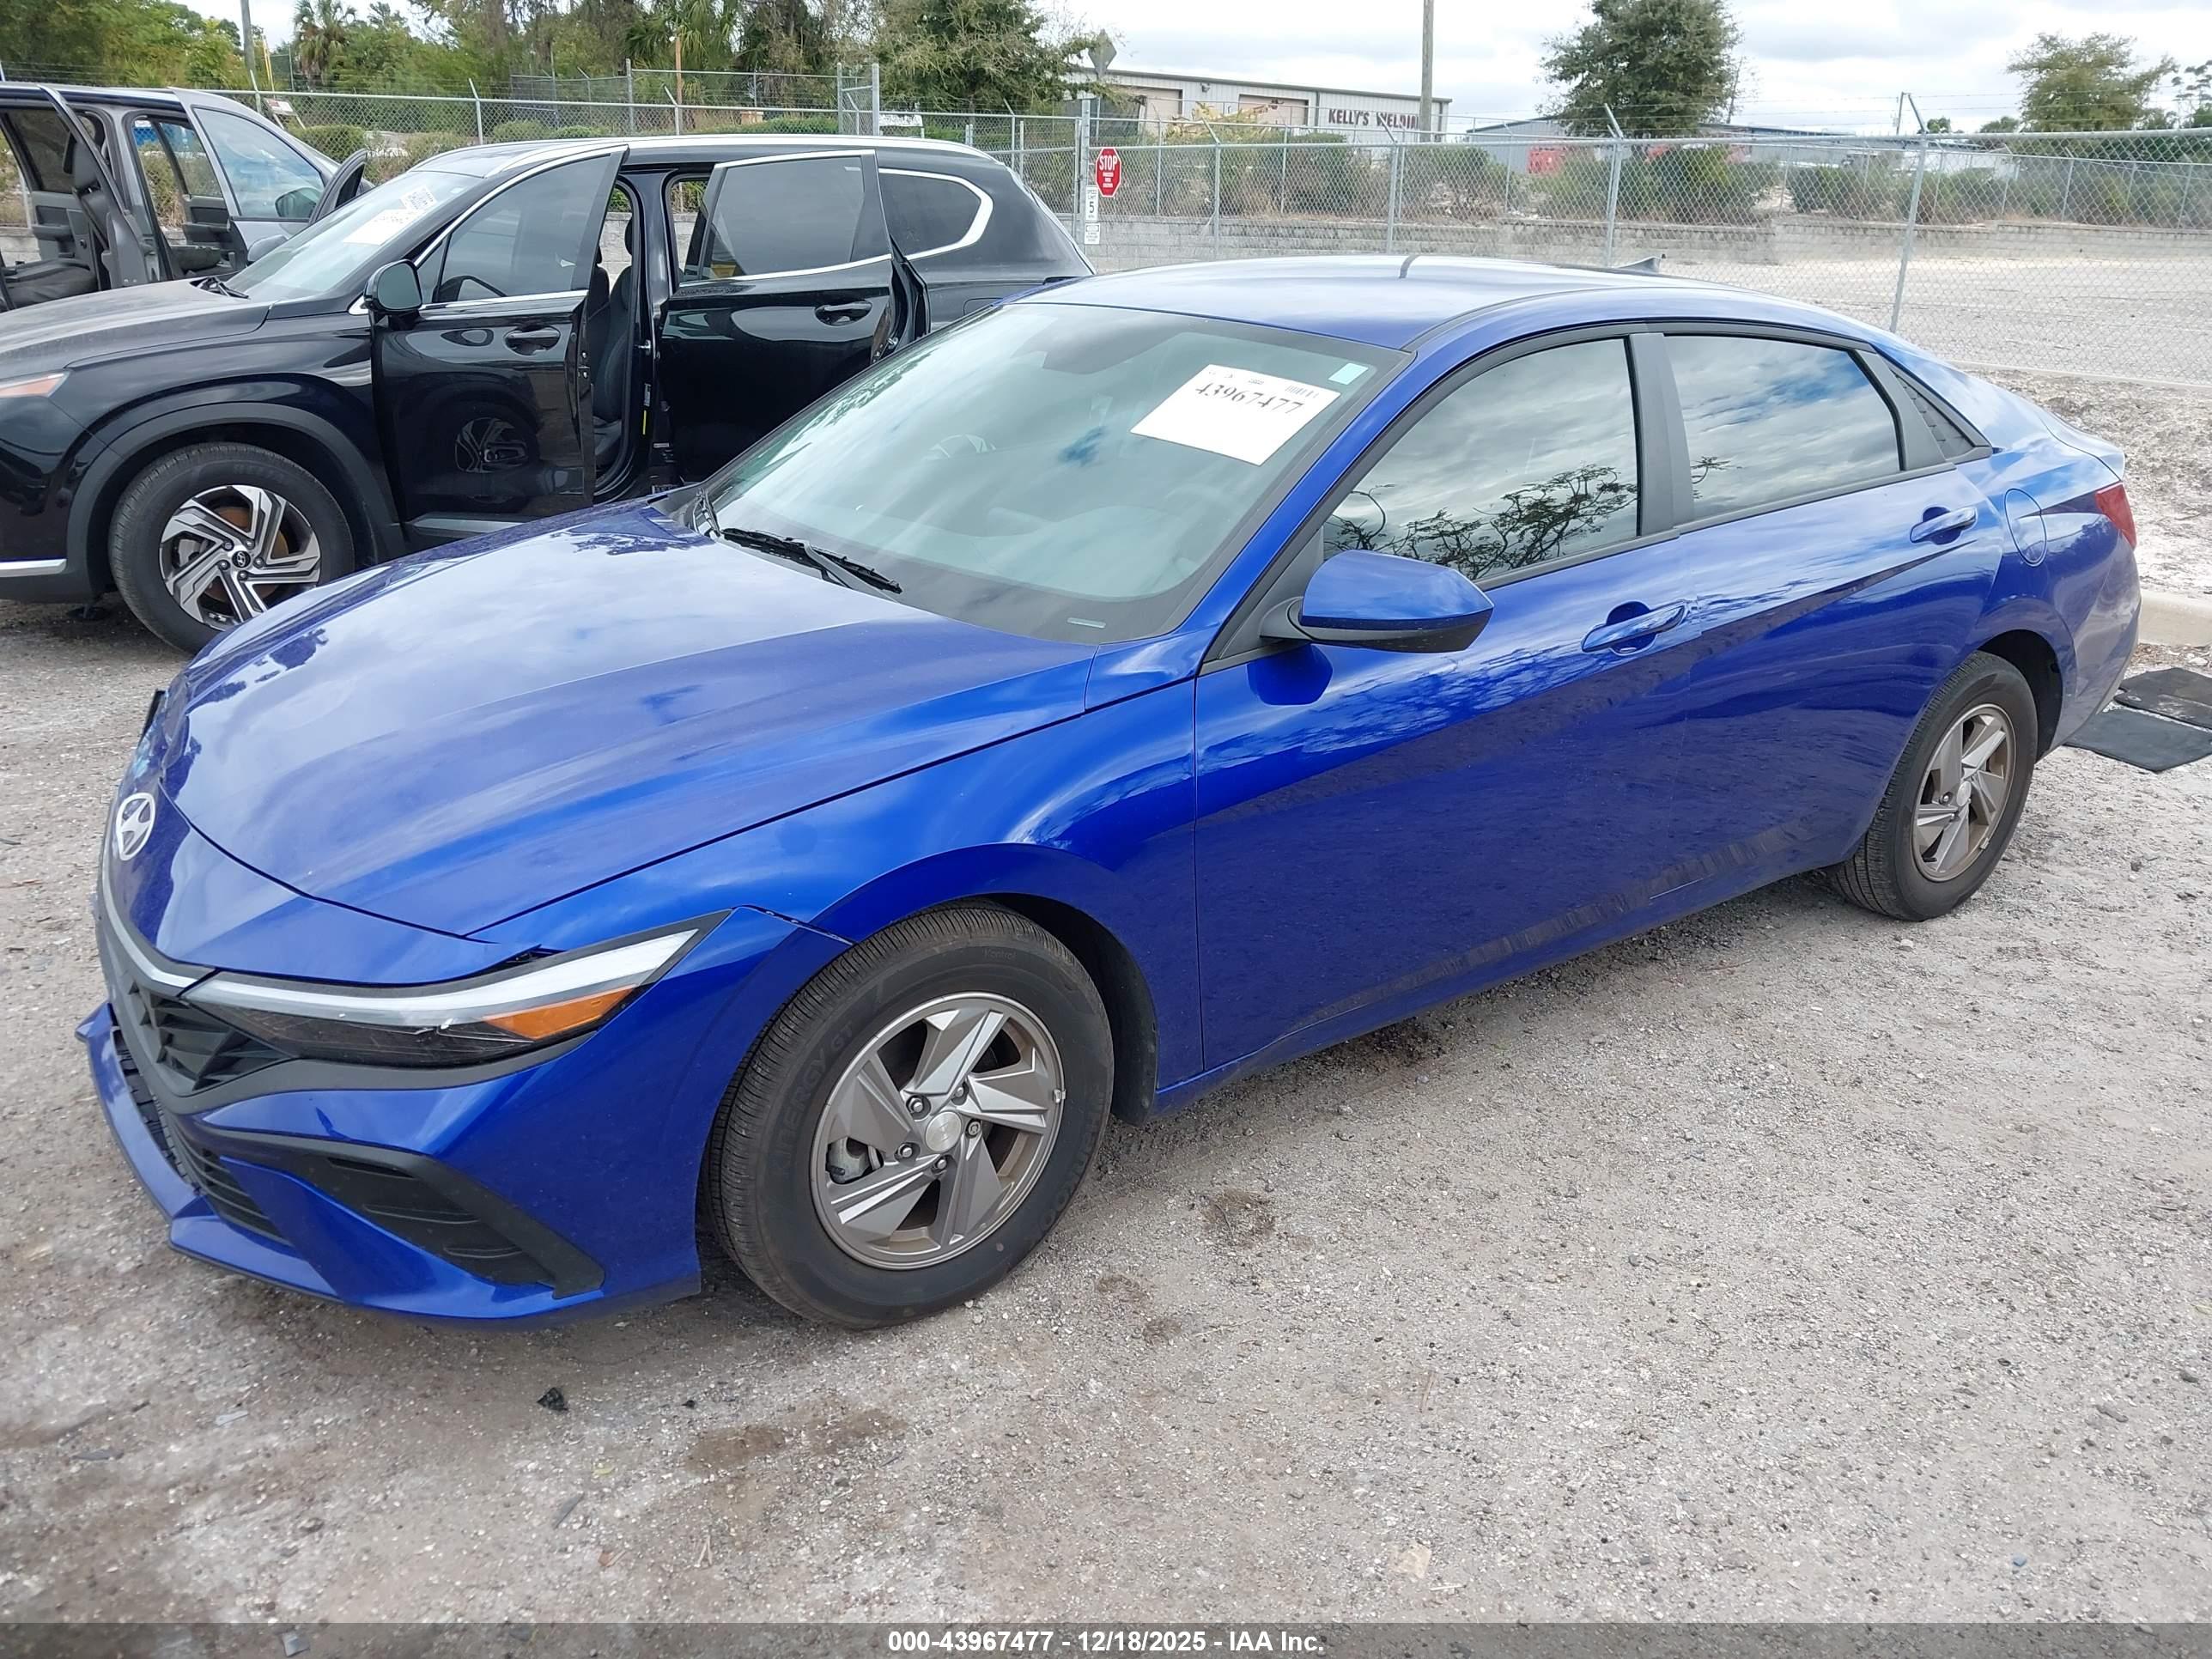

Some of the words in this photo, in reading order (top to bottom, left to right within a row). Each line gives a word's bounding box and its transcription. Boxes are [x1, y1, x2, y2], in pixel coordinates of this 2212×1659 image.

[1328, 108, 1370, 125] KELLY'S
[1376, 111, 1419, 130] WELDIN
[1099, 155, 1117, 170] STOP
[1089, 201, 1095, 213] 5
[1195, 382, 1304, 414] 43967477
